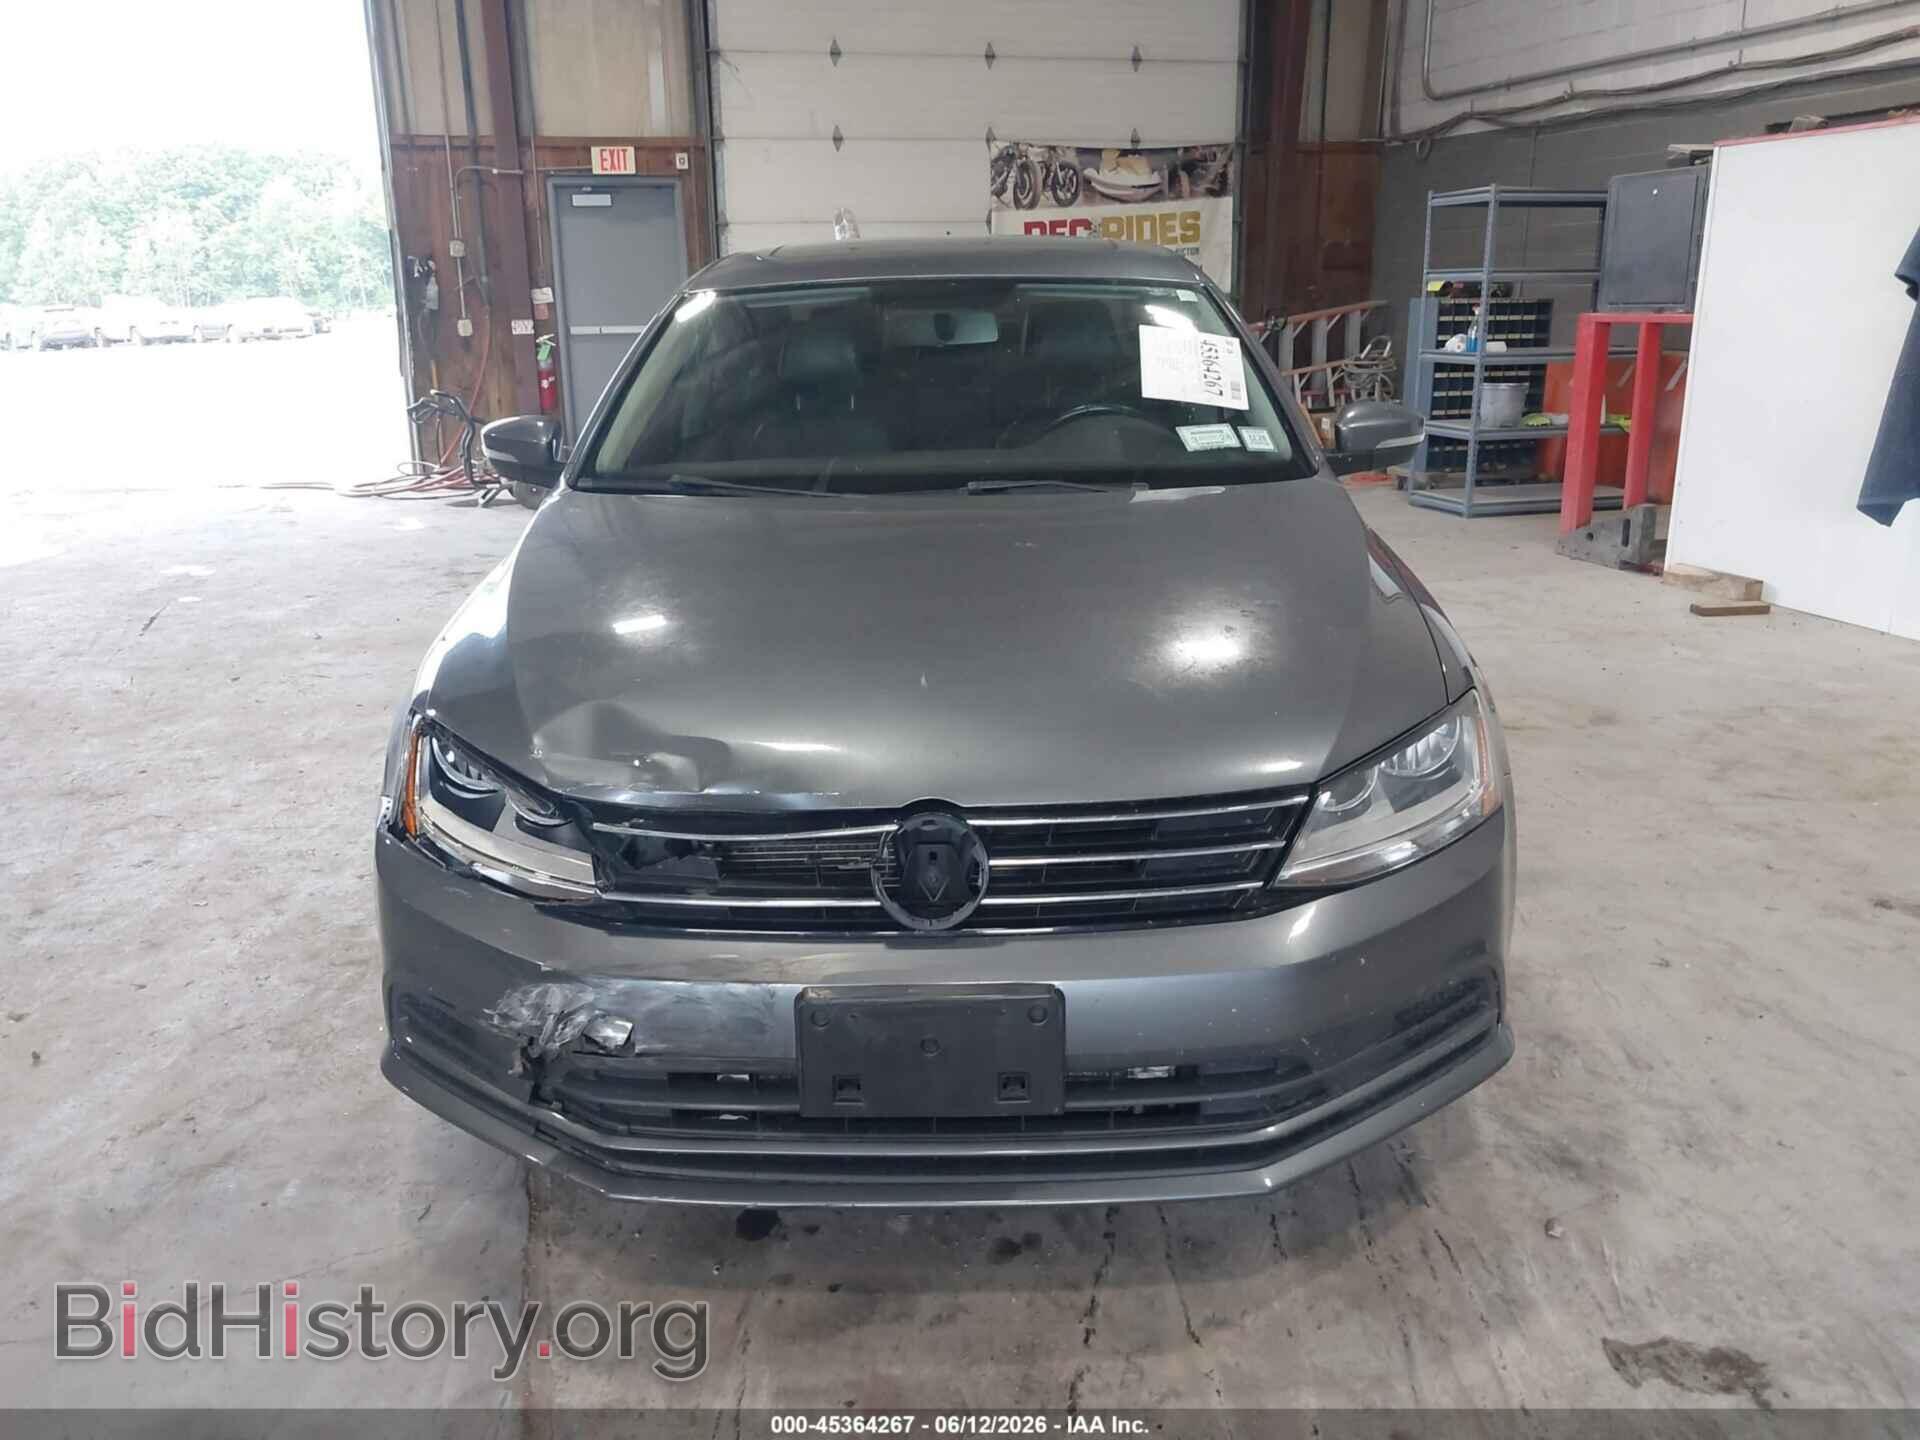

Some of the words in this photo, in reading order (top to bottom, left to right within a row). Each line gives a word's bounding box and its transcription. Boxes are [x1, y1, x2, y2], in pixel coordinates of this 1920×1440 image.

[600, 148, 628, 171] EXIT
[1102, 211, 1201, 245] RIDES
[1200, 338, 1224, 397] 45364267
